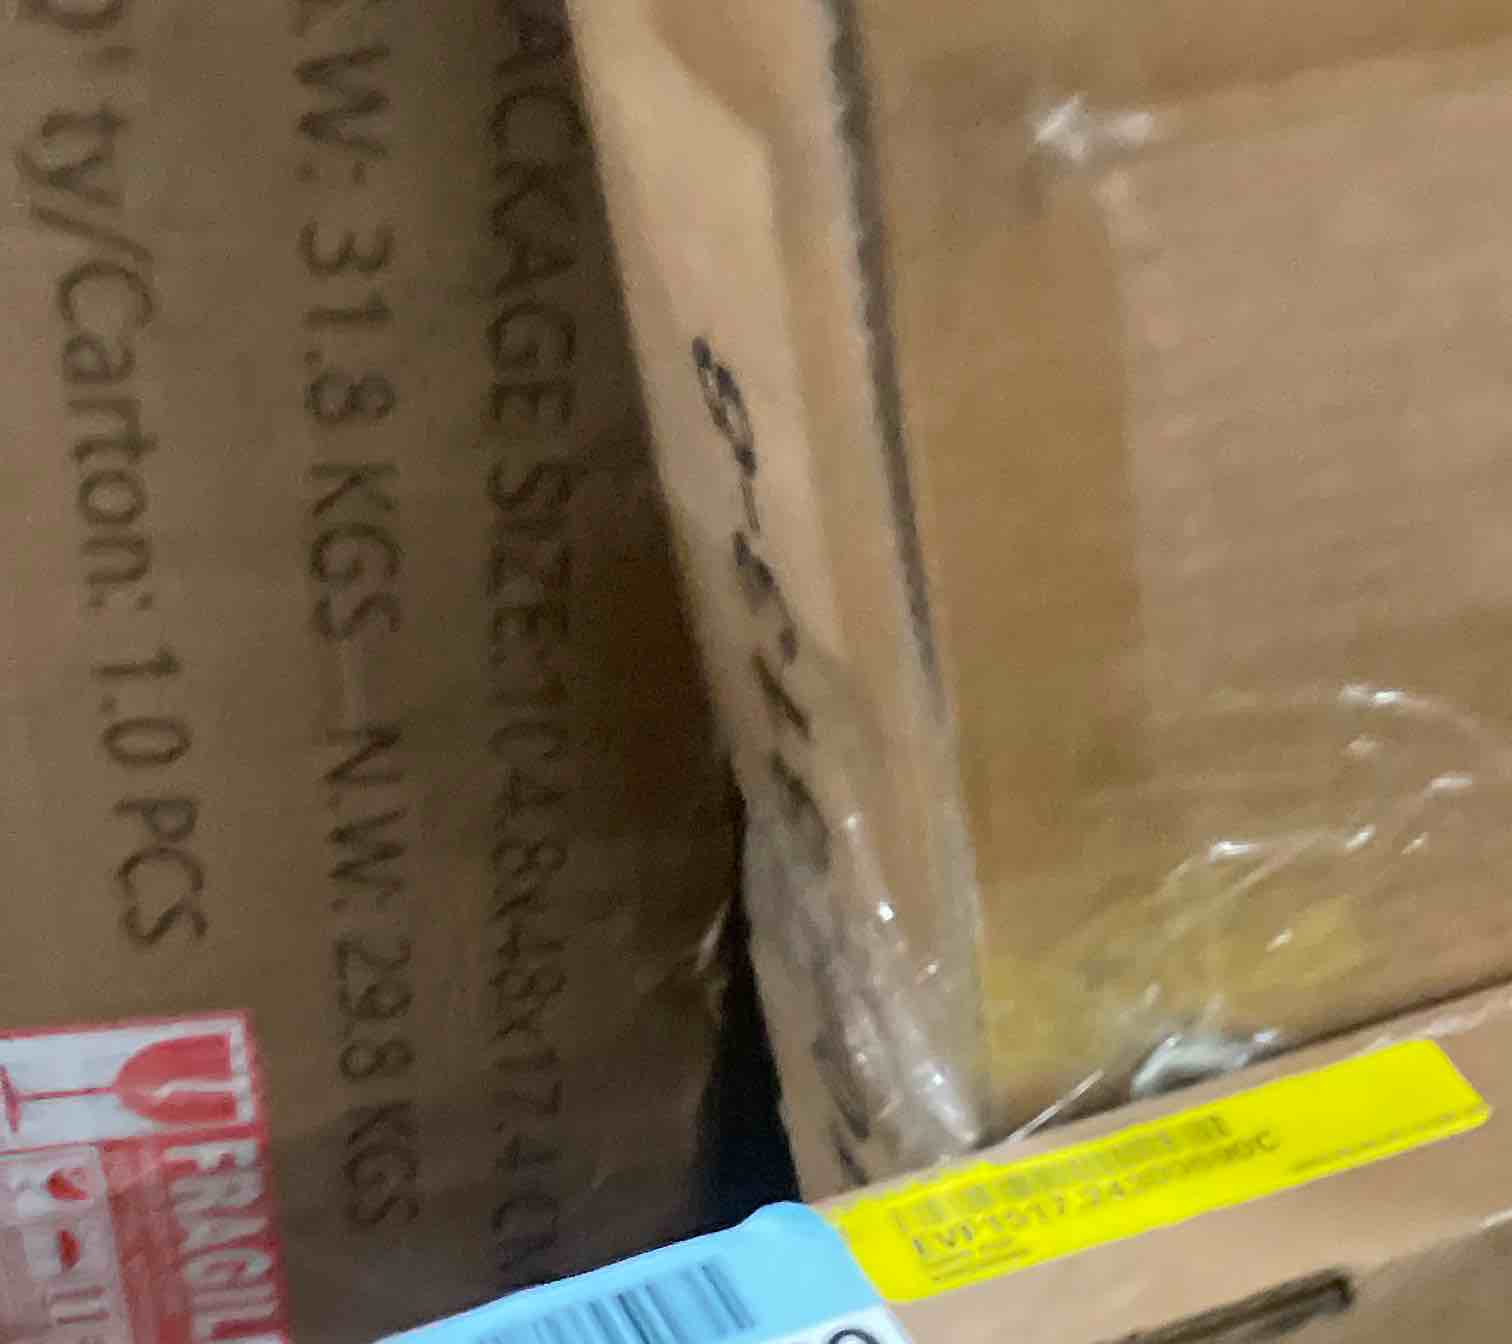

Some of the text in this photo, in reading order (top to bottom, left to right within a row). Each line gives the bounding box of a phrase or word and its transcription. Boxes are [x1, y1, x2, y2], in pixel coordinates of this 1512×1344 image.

[302, 222, 396, 426] 31.8
[308, 464, 401, 642] KGS
[113, 798, 206, 948] PCS
